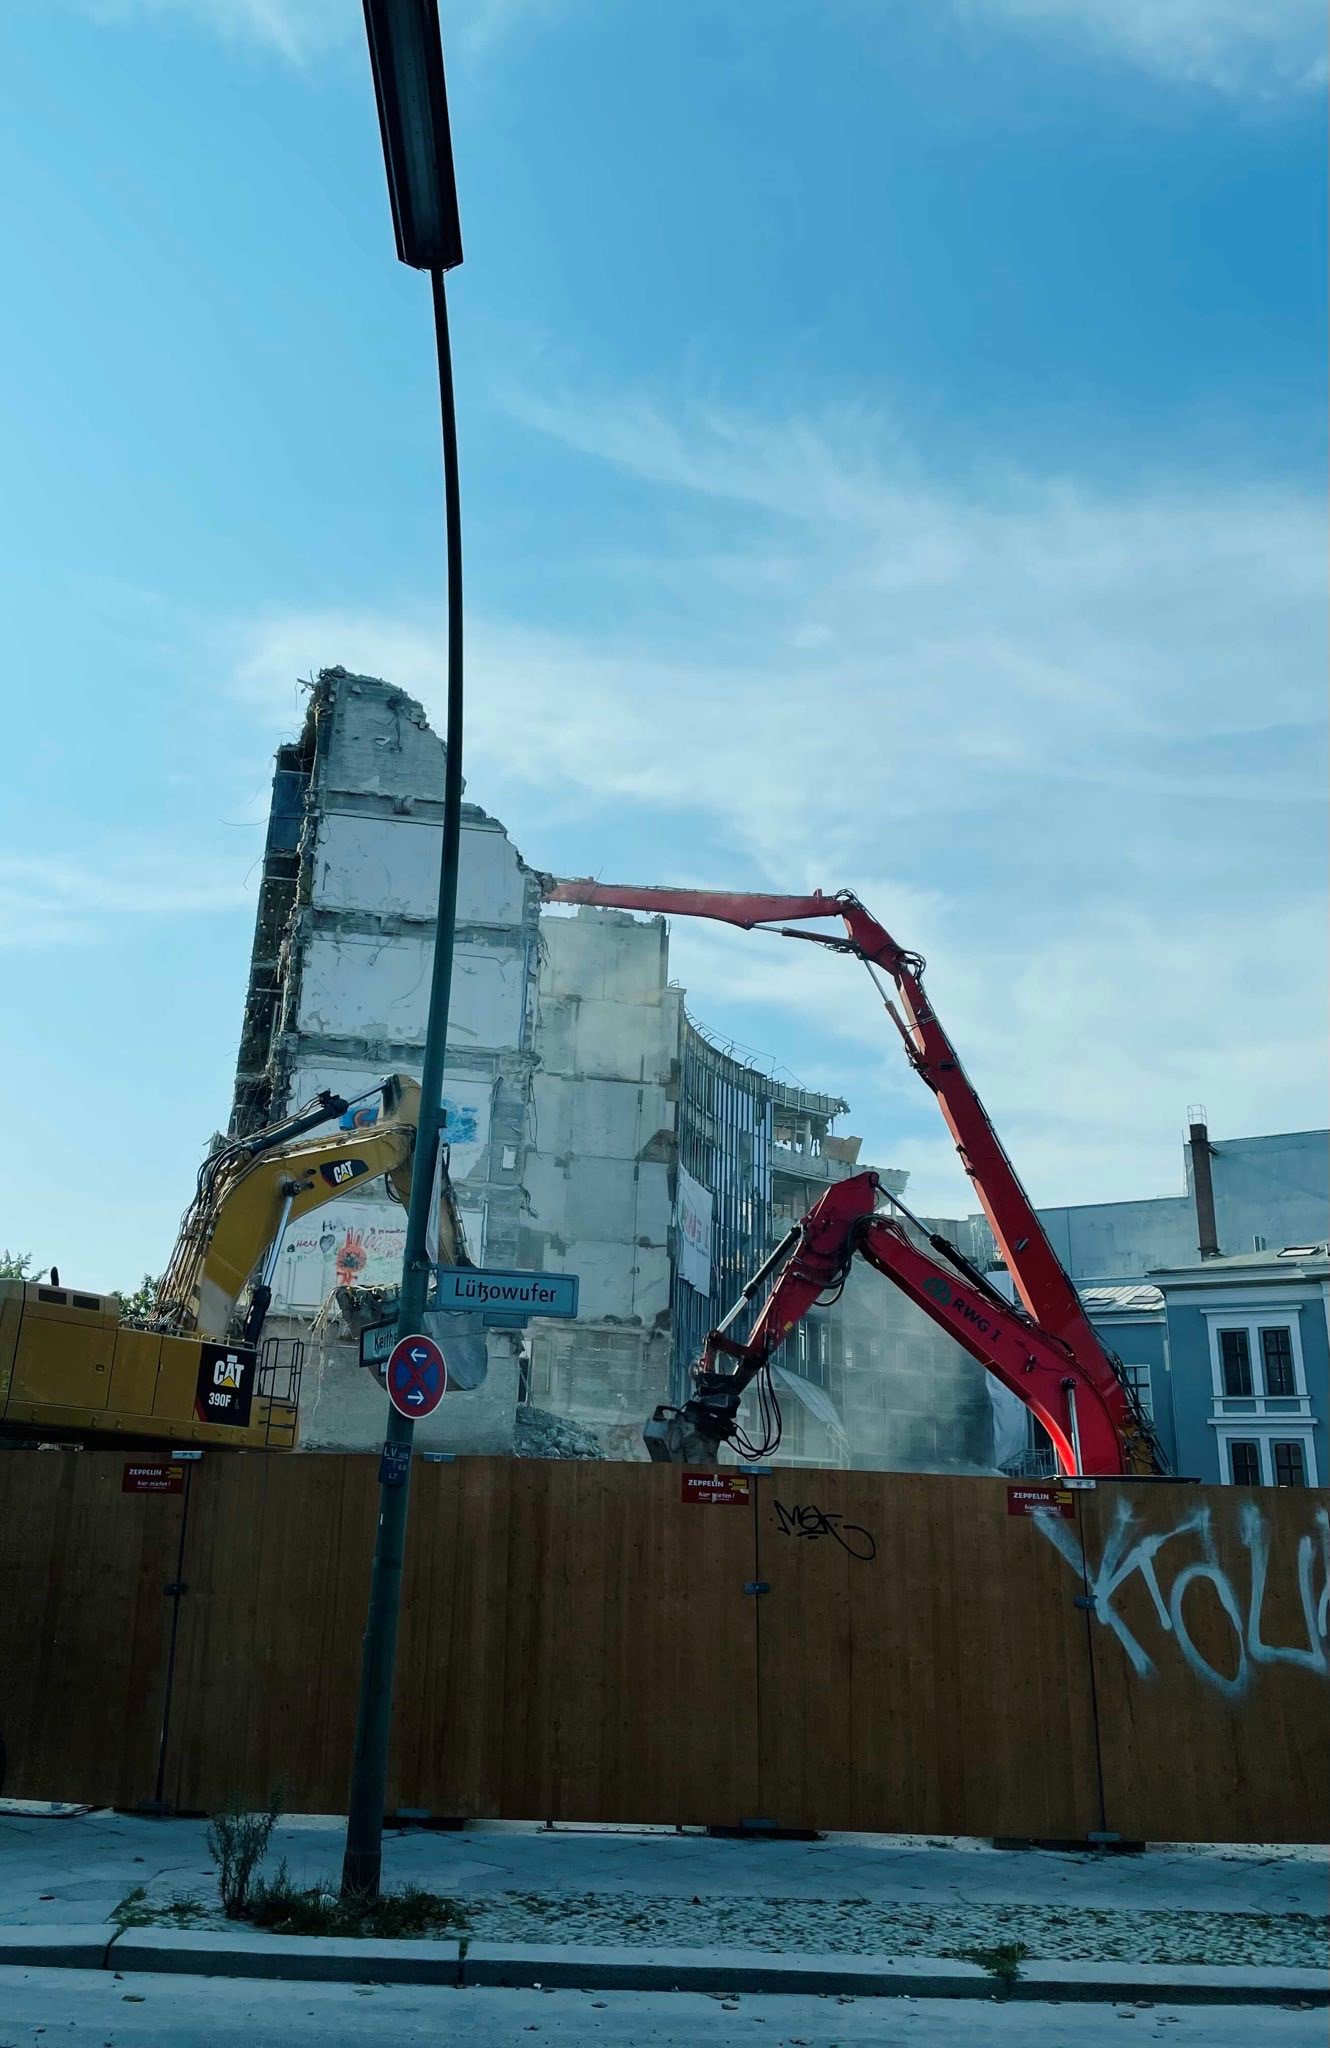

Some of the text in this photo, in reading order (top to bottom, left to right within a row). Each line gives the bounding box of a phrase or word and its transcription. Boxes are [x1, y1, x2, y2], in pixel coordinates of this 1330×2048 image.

[333, 1160, 354, 1184] CAT
[455, 1277, 557, 1303] Lützowufer
[951, 1297, 992, 1334] RWG
[374, 1328, 399, 1350] Keiths
[213, 1360, 245, 1389] CAT
[208, 1392, 232, 1408] 390F
[128, 1468, 162, 1476] ZEPPELIN
[687, 1479, 724, 1488] ZEPPELIN
[1013, 1492, 1050, 1500] ZEPPELIN
